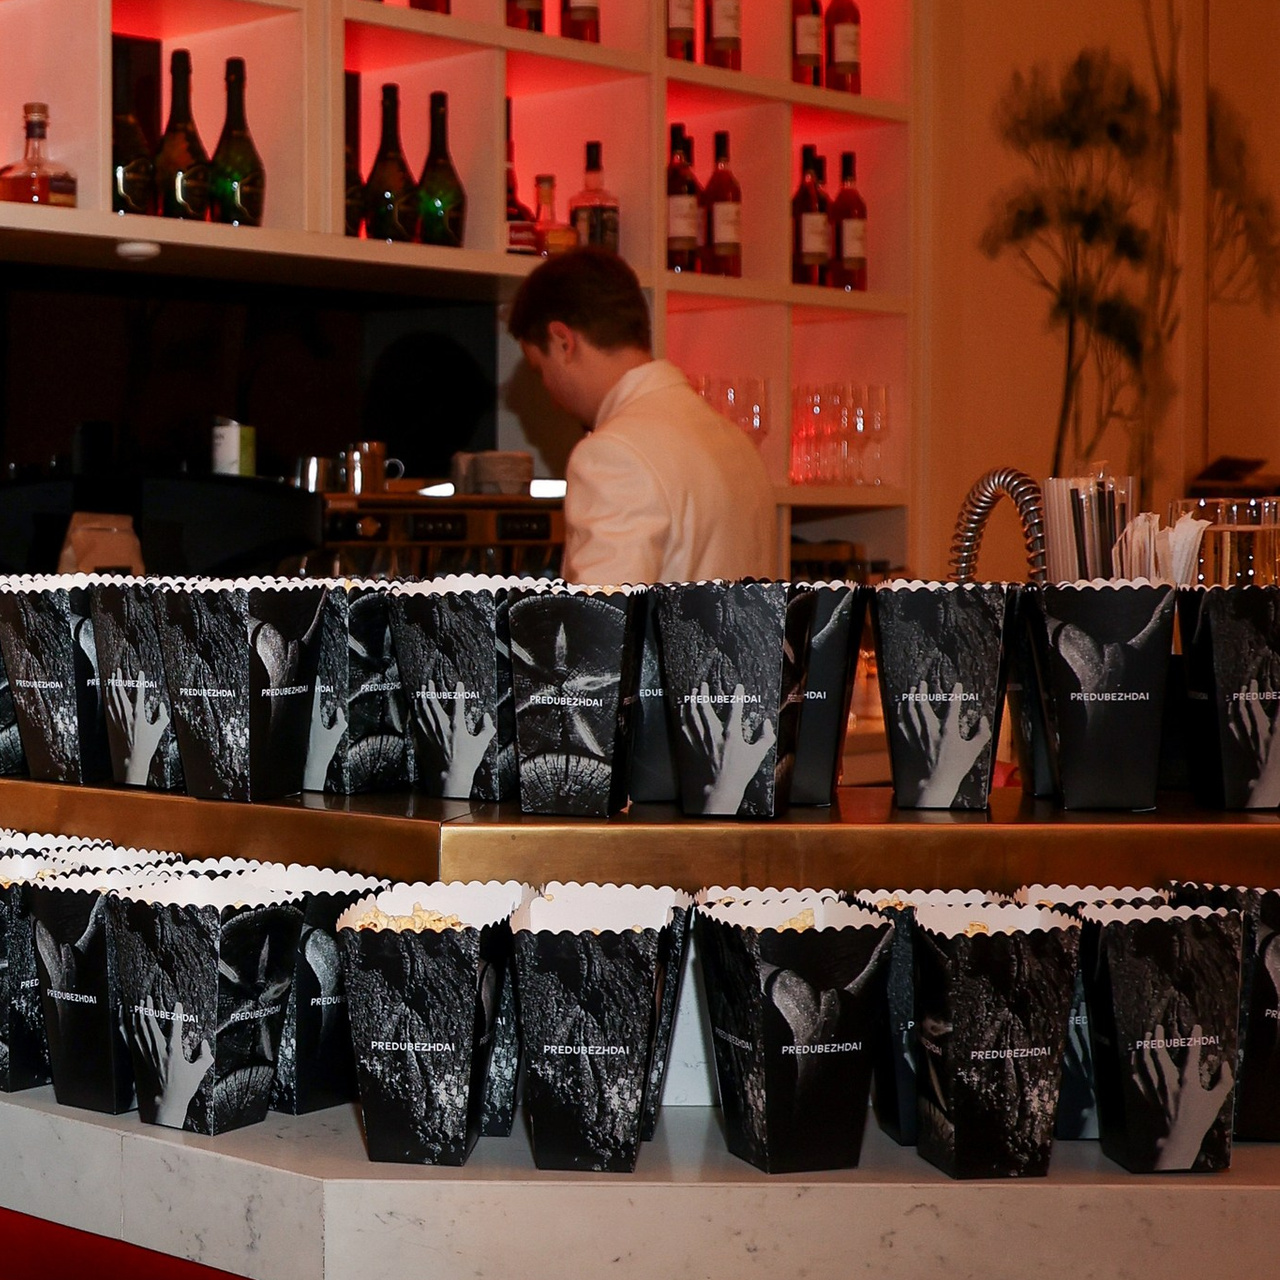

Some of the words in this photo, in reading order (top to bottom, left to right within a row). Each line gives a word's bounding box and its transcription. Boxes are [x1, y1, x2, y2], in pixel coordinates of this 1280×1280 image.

[15, 679, 63, 689] PREDUBEZHDAI
[179, 687, 236, 698] PREDUBEZHDAI
[261, 685, 309, 697] PREDUBEZHDAI
[415, 690, 480, 700] PREDUBEZHDAI
[1070, 692, 1150, 701] PREDUBEZHDAI
[529, 695, 603, 708] PREDUBEZHDAI
[683, 694, 761, 704] PREDUBEZHDAI
[901, 693, 979, 702] PREDUBEZHDAI
[46, 988, 97, 1004] PREDUBEZHDAI
[134, 1005, 199, 1023] PREDUBEZHDAI
[230, 1004, 282, 1022] PREDUBEZHDAI
[371, 1040, 455, 1052] PREDUBEZHDAI
[781, 1041, 862, 1054] PREDUBEZHDAI
[1136, 1035, 1220, 1049] PREDUBEZHDAI
[543, 1044, 629, 1055] PREDUBEZHDAI
[970, 1046, 1051, 1060] PREDUBEZHDAI
